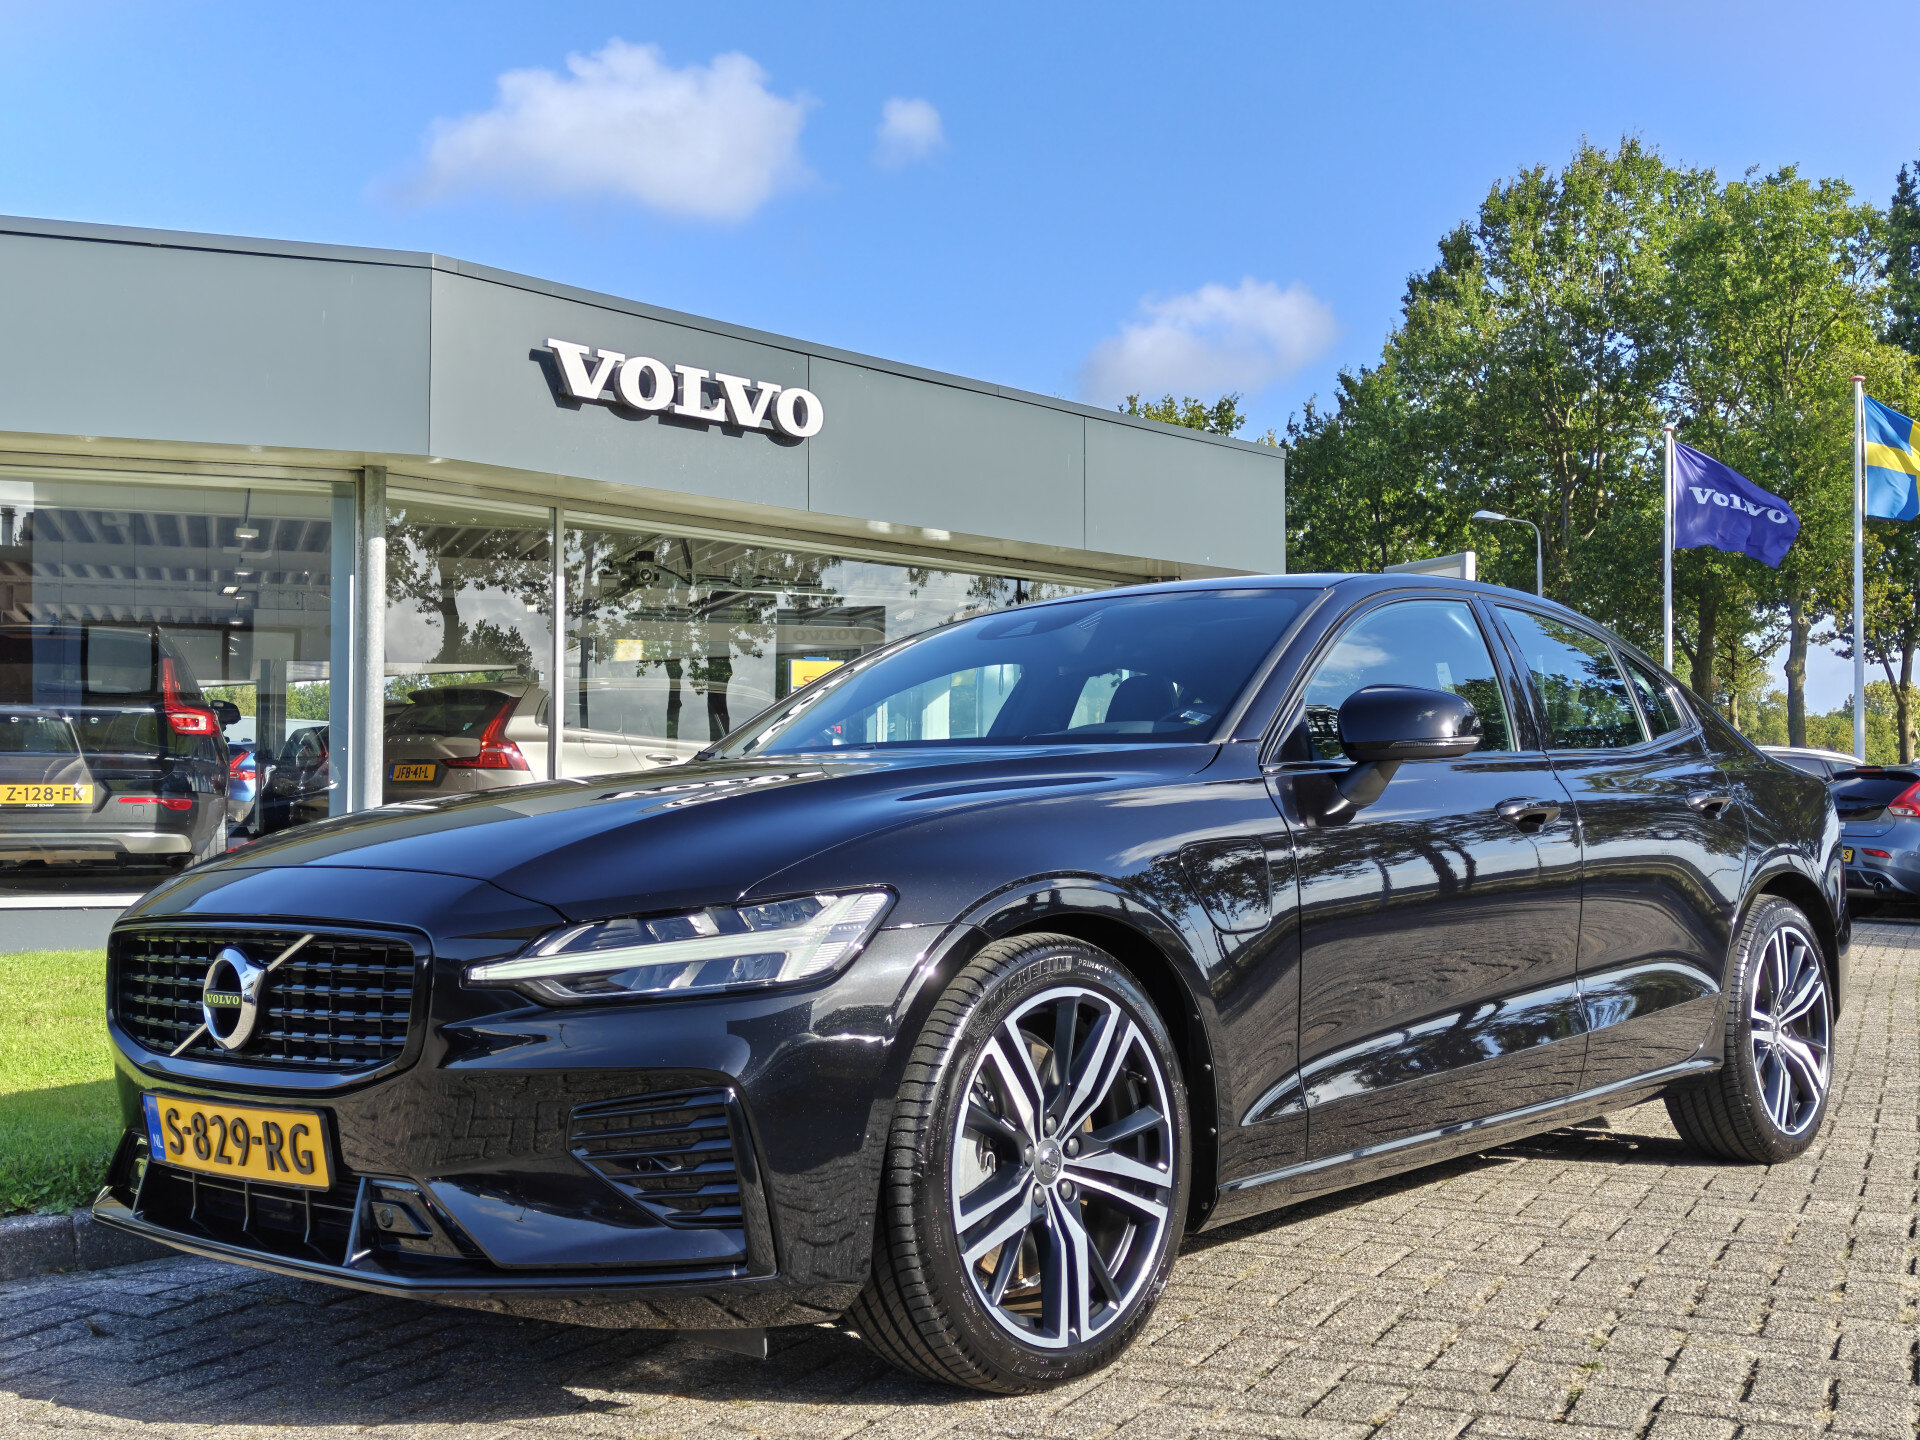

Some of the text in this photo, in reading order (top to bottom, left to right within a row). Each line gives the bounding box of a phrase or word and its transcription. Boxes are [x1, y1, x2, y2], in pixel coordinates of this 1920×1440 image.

[543, 338, 824, 438] VOLVO
[1689, 486, 1788, 524] VOLVO
[396, 766, 429, 779] JFB-41-L
[6, 787, 83, 801] Z-128-FK
[1078, 959, 1109, 974] PRIMACY
[206, 993, 240, 1005] VOLVO
[153, 1133, 163, 1149] NL
[166, 1108, 315, 1175] S-829-RG
